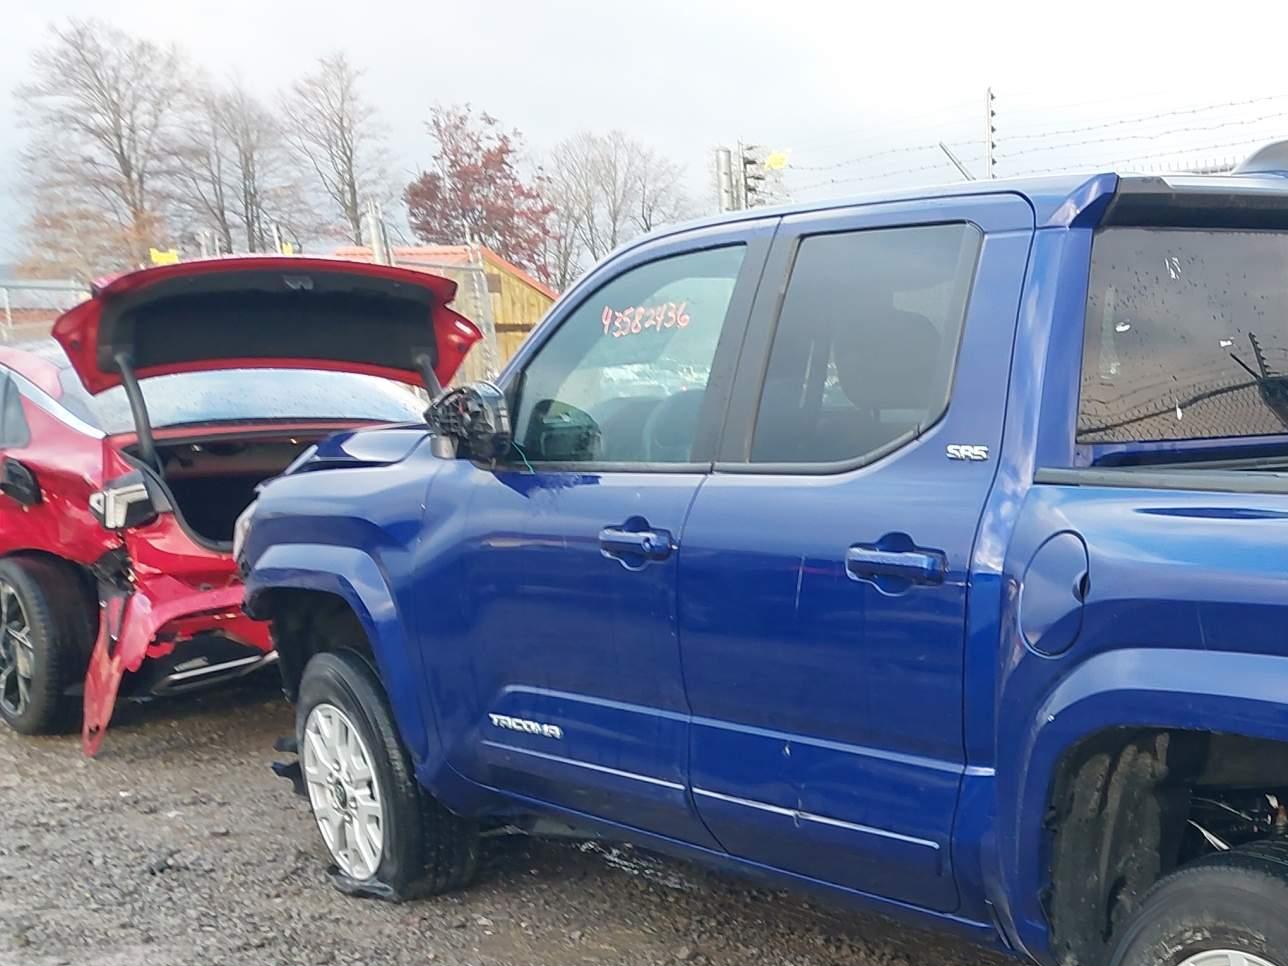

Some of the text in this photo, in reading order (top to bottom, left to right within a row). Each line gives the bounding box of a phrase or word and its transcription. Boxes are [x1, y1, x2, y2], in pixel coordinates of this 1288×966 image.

[601, 302, 690, 337] 43582436
[945, 444, 989, 460] SR5
[488, 712, 564, 739] TACOMA
